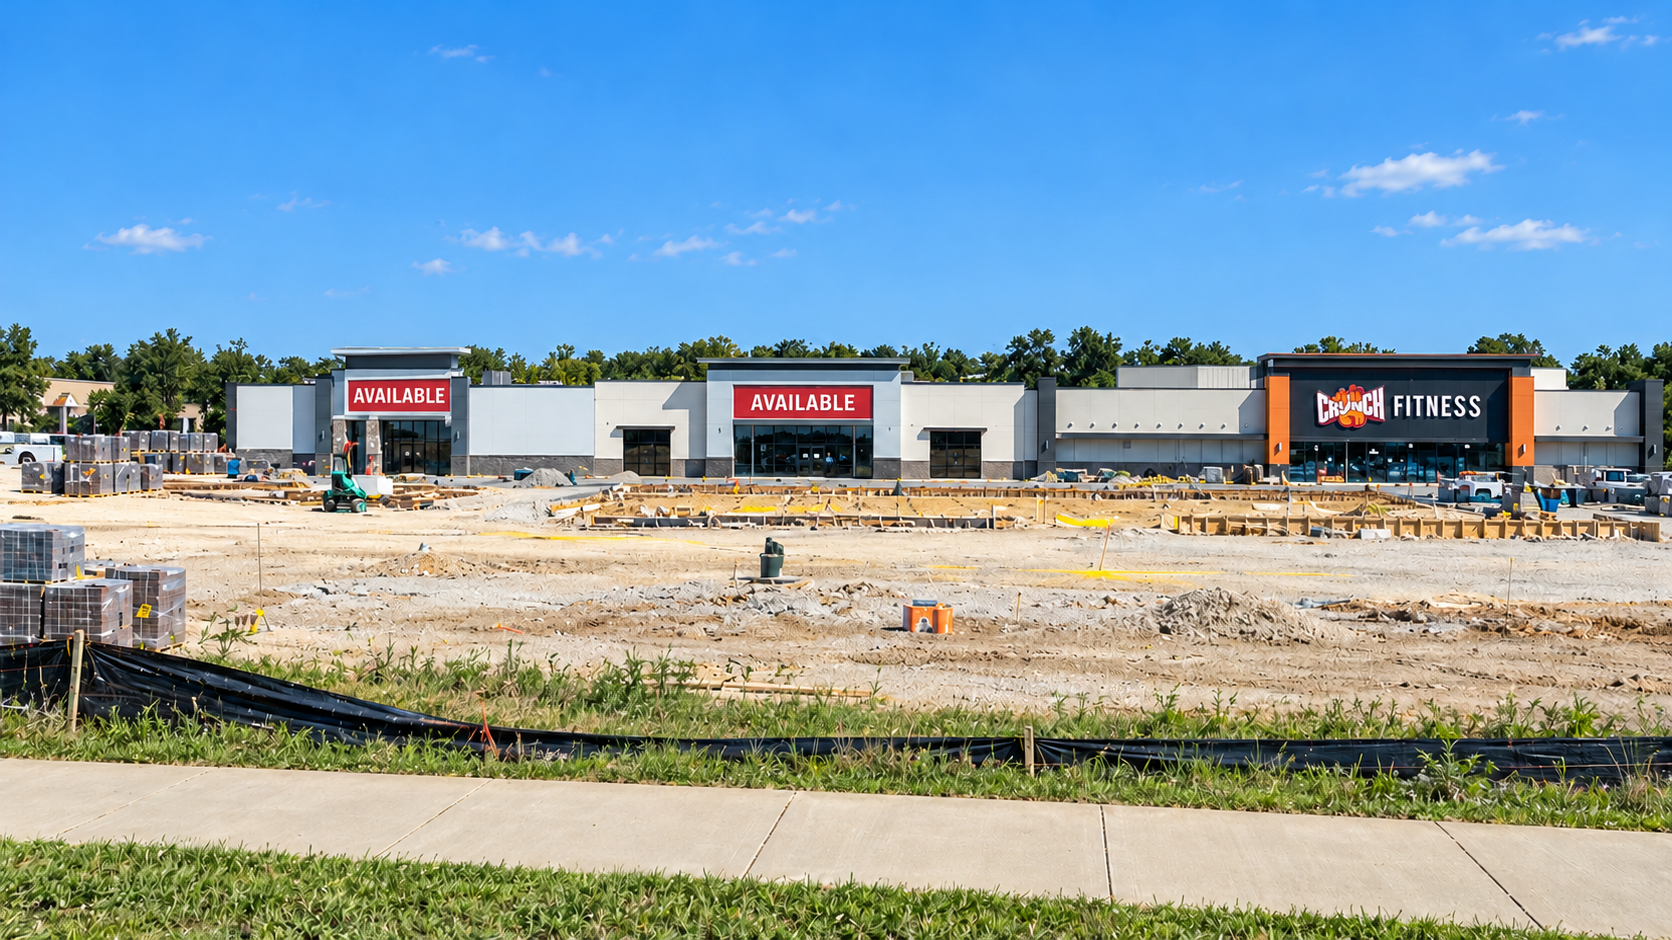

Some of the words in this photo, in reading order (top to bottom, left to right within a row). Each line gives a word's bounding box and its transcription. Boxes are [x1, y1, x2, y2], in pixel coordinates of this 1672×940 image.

[353, 387, 446, 404] AVAILABLE
[750, 393, 856, 411] AVAILABLE
[1316, 386, 1386, 424] CRUNCH
[1393, 395, 1481, 418] FITNESS
